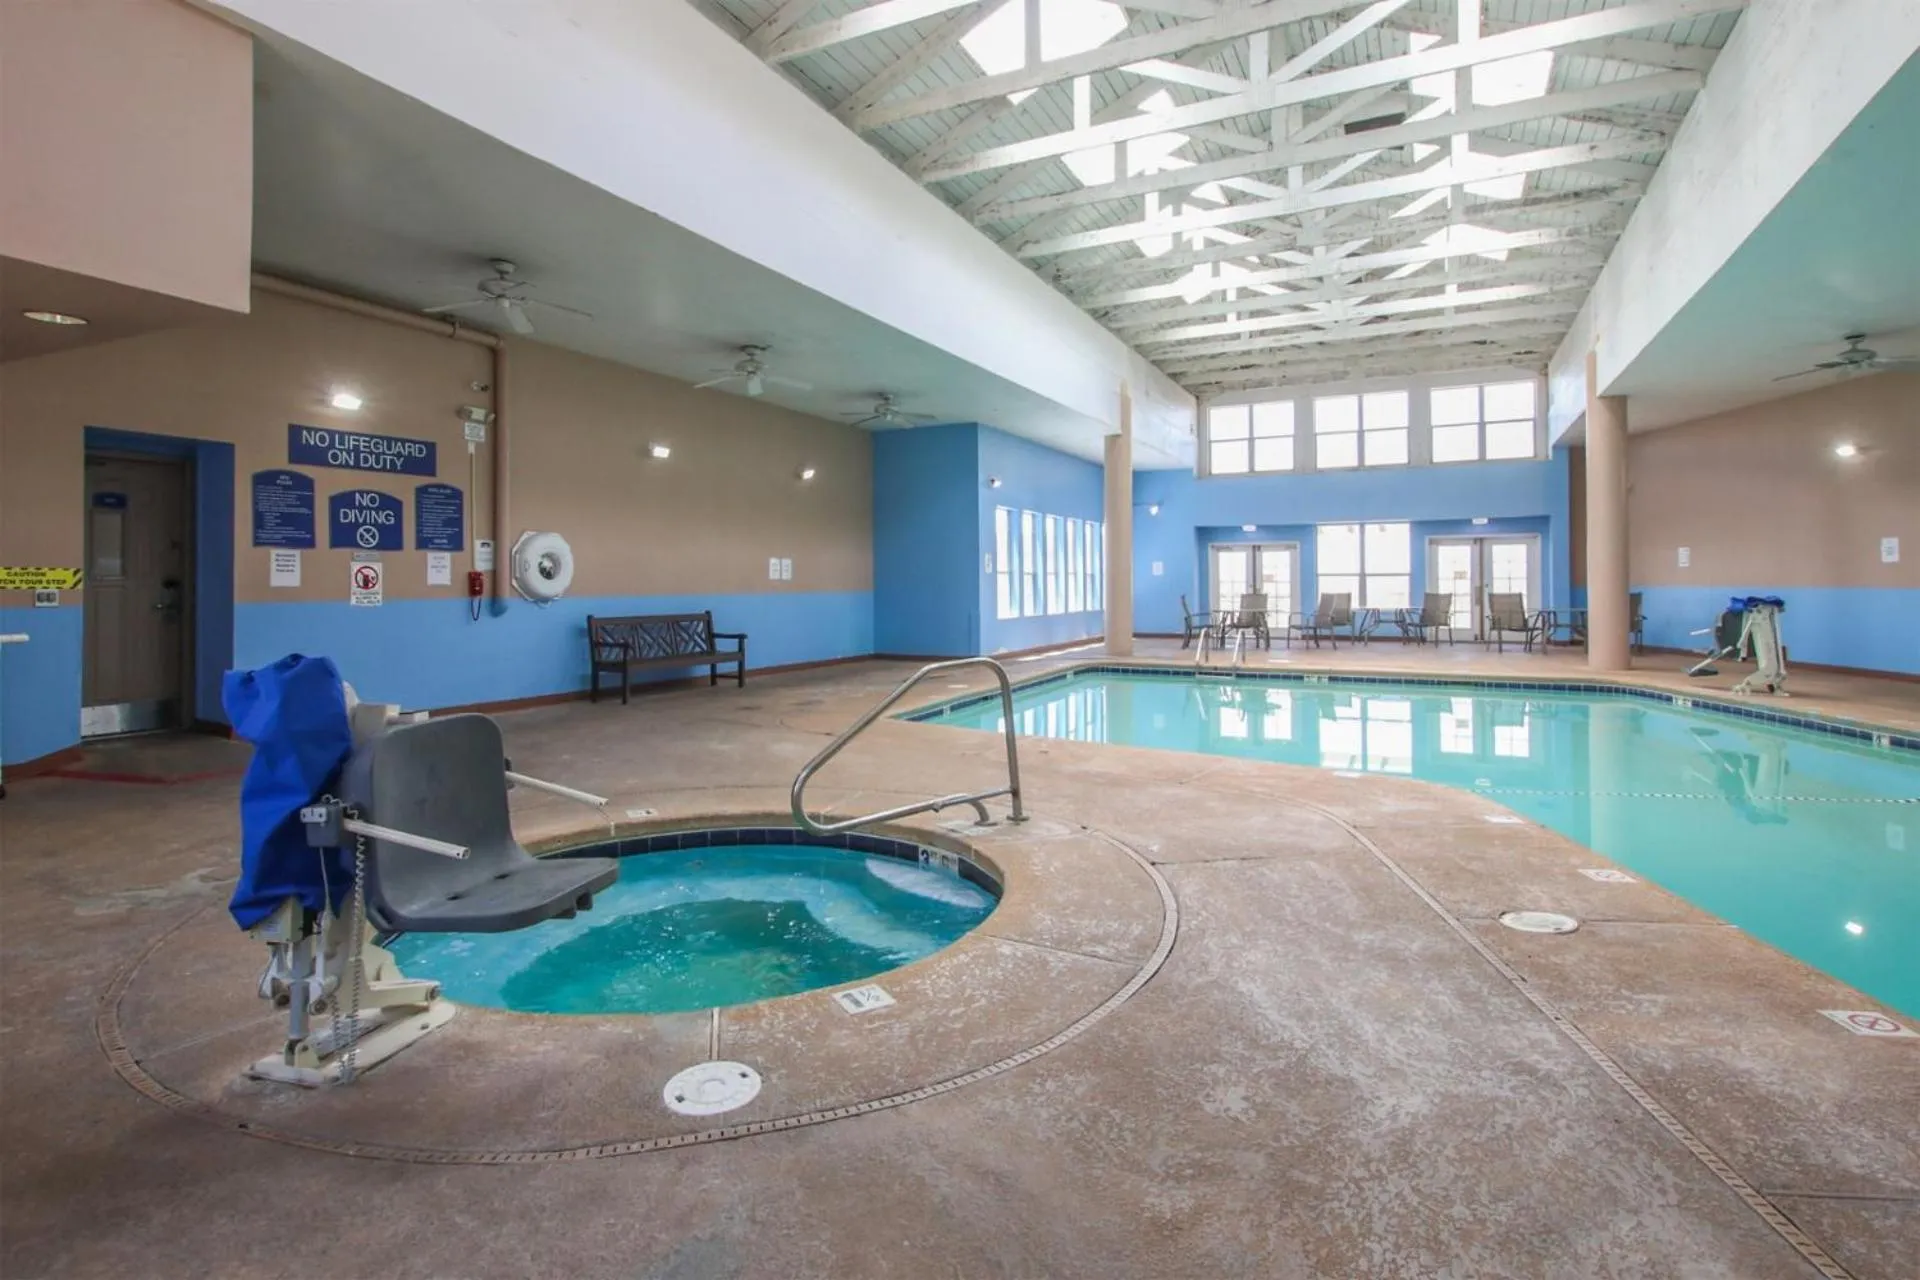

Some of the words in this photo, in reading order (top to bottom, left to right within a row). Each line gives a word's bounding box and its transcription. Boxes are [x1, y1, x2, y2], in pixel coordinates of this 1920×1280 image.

[302, 430, 329, 447] NO
[335, 434, 426, 457] LIFEGUARD
[328, 450, 354, 466] ON
[360, 454, 405, 469] DUTY
[355, 492, 379, 507] NO
[340, 508, 395, 525] DIVING
